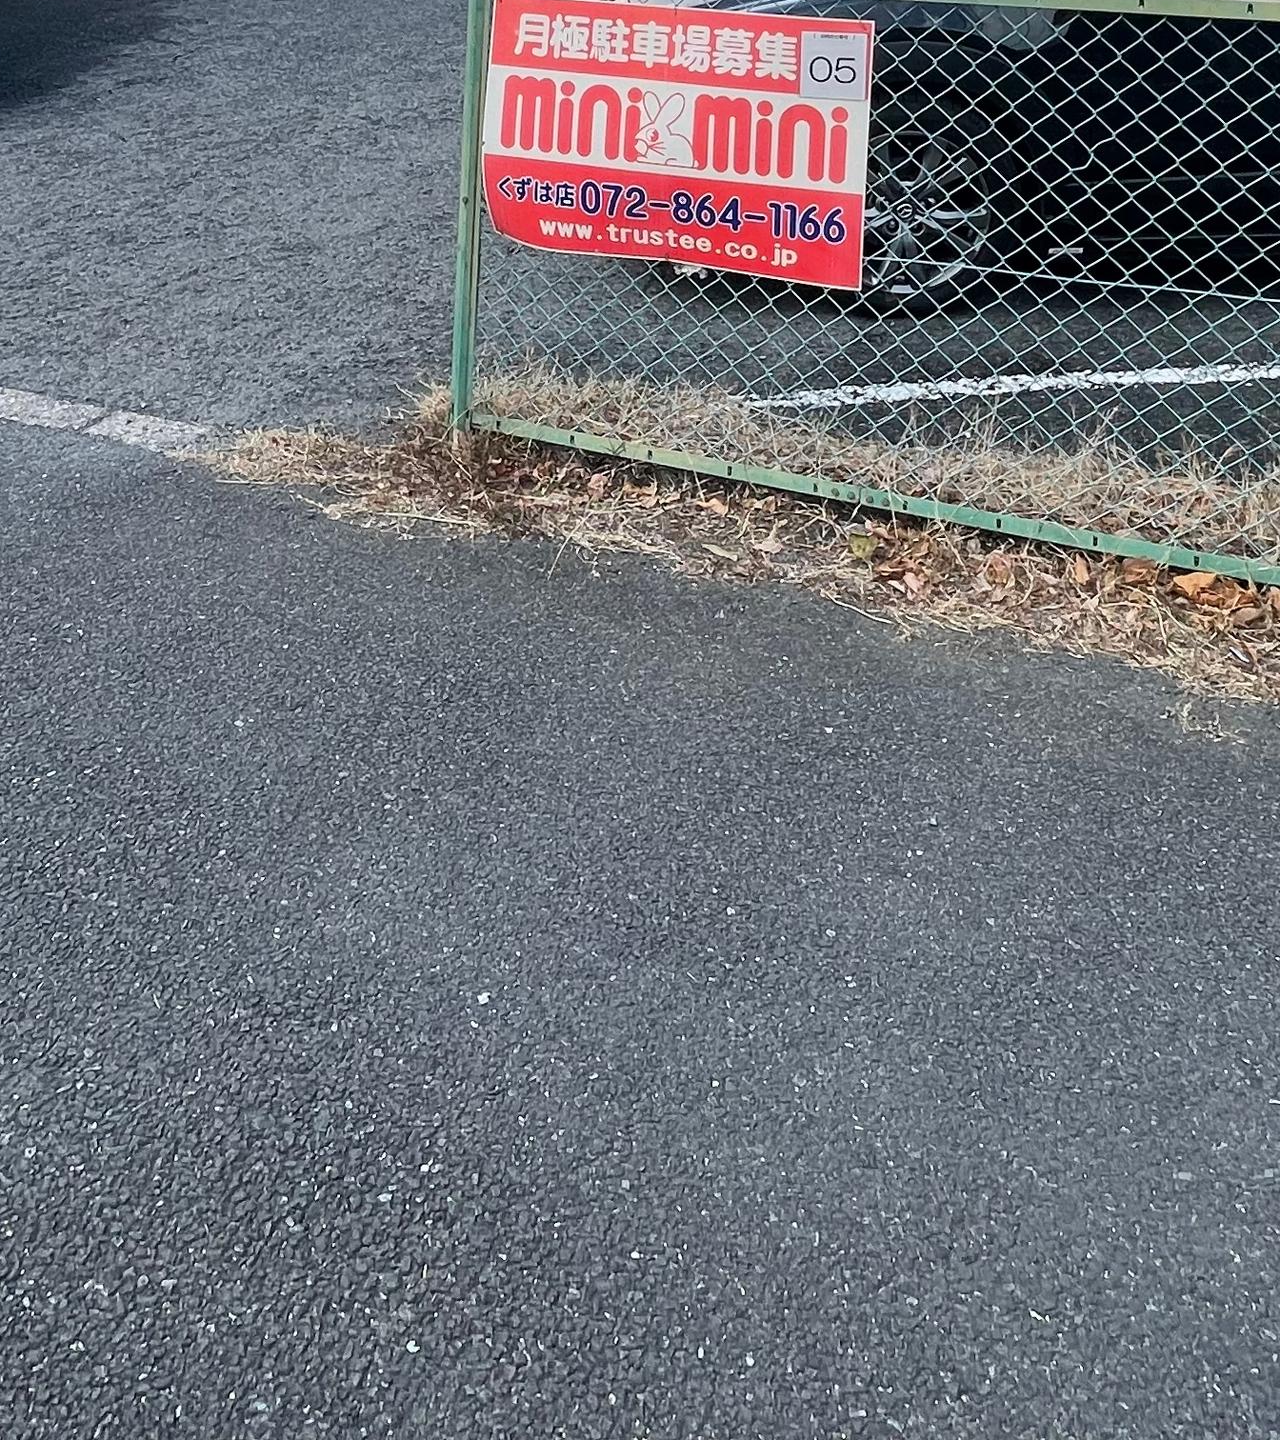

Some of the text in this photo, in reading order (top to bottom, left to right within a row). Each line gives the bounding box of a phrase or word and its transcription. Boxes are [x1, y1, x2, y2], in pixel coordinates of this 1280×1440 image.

[514, 13, 797, 81] 月極駐車場募集
[810, 56, 856, 83] 05
[500, 75, 849, 184] mini mini
[498, 177, 847, 244] くずは店 072-864-1166
[539, 219, 799, 268] www.trustee.co.jp
